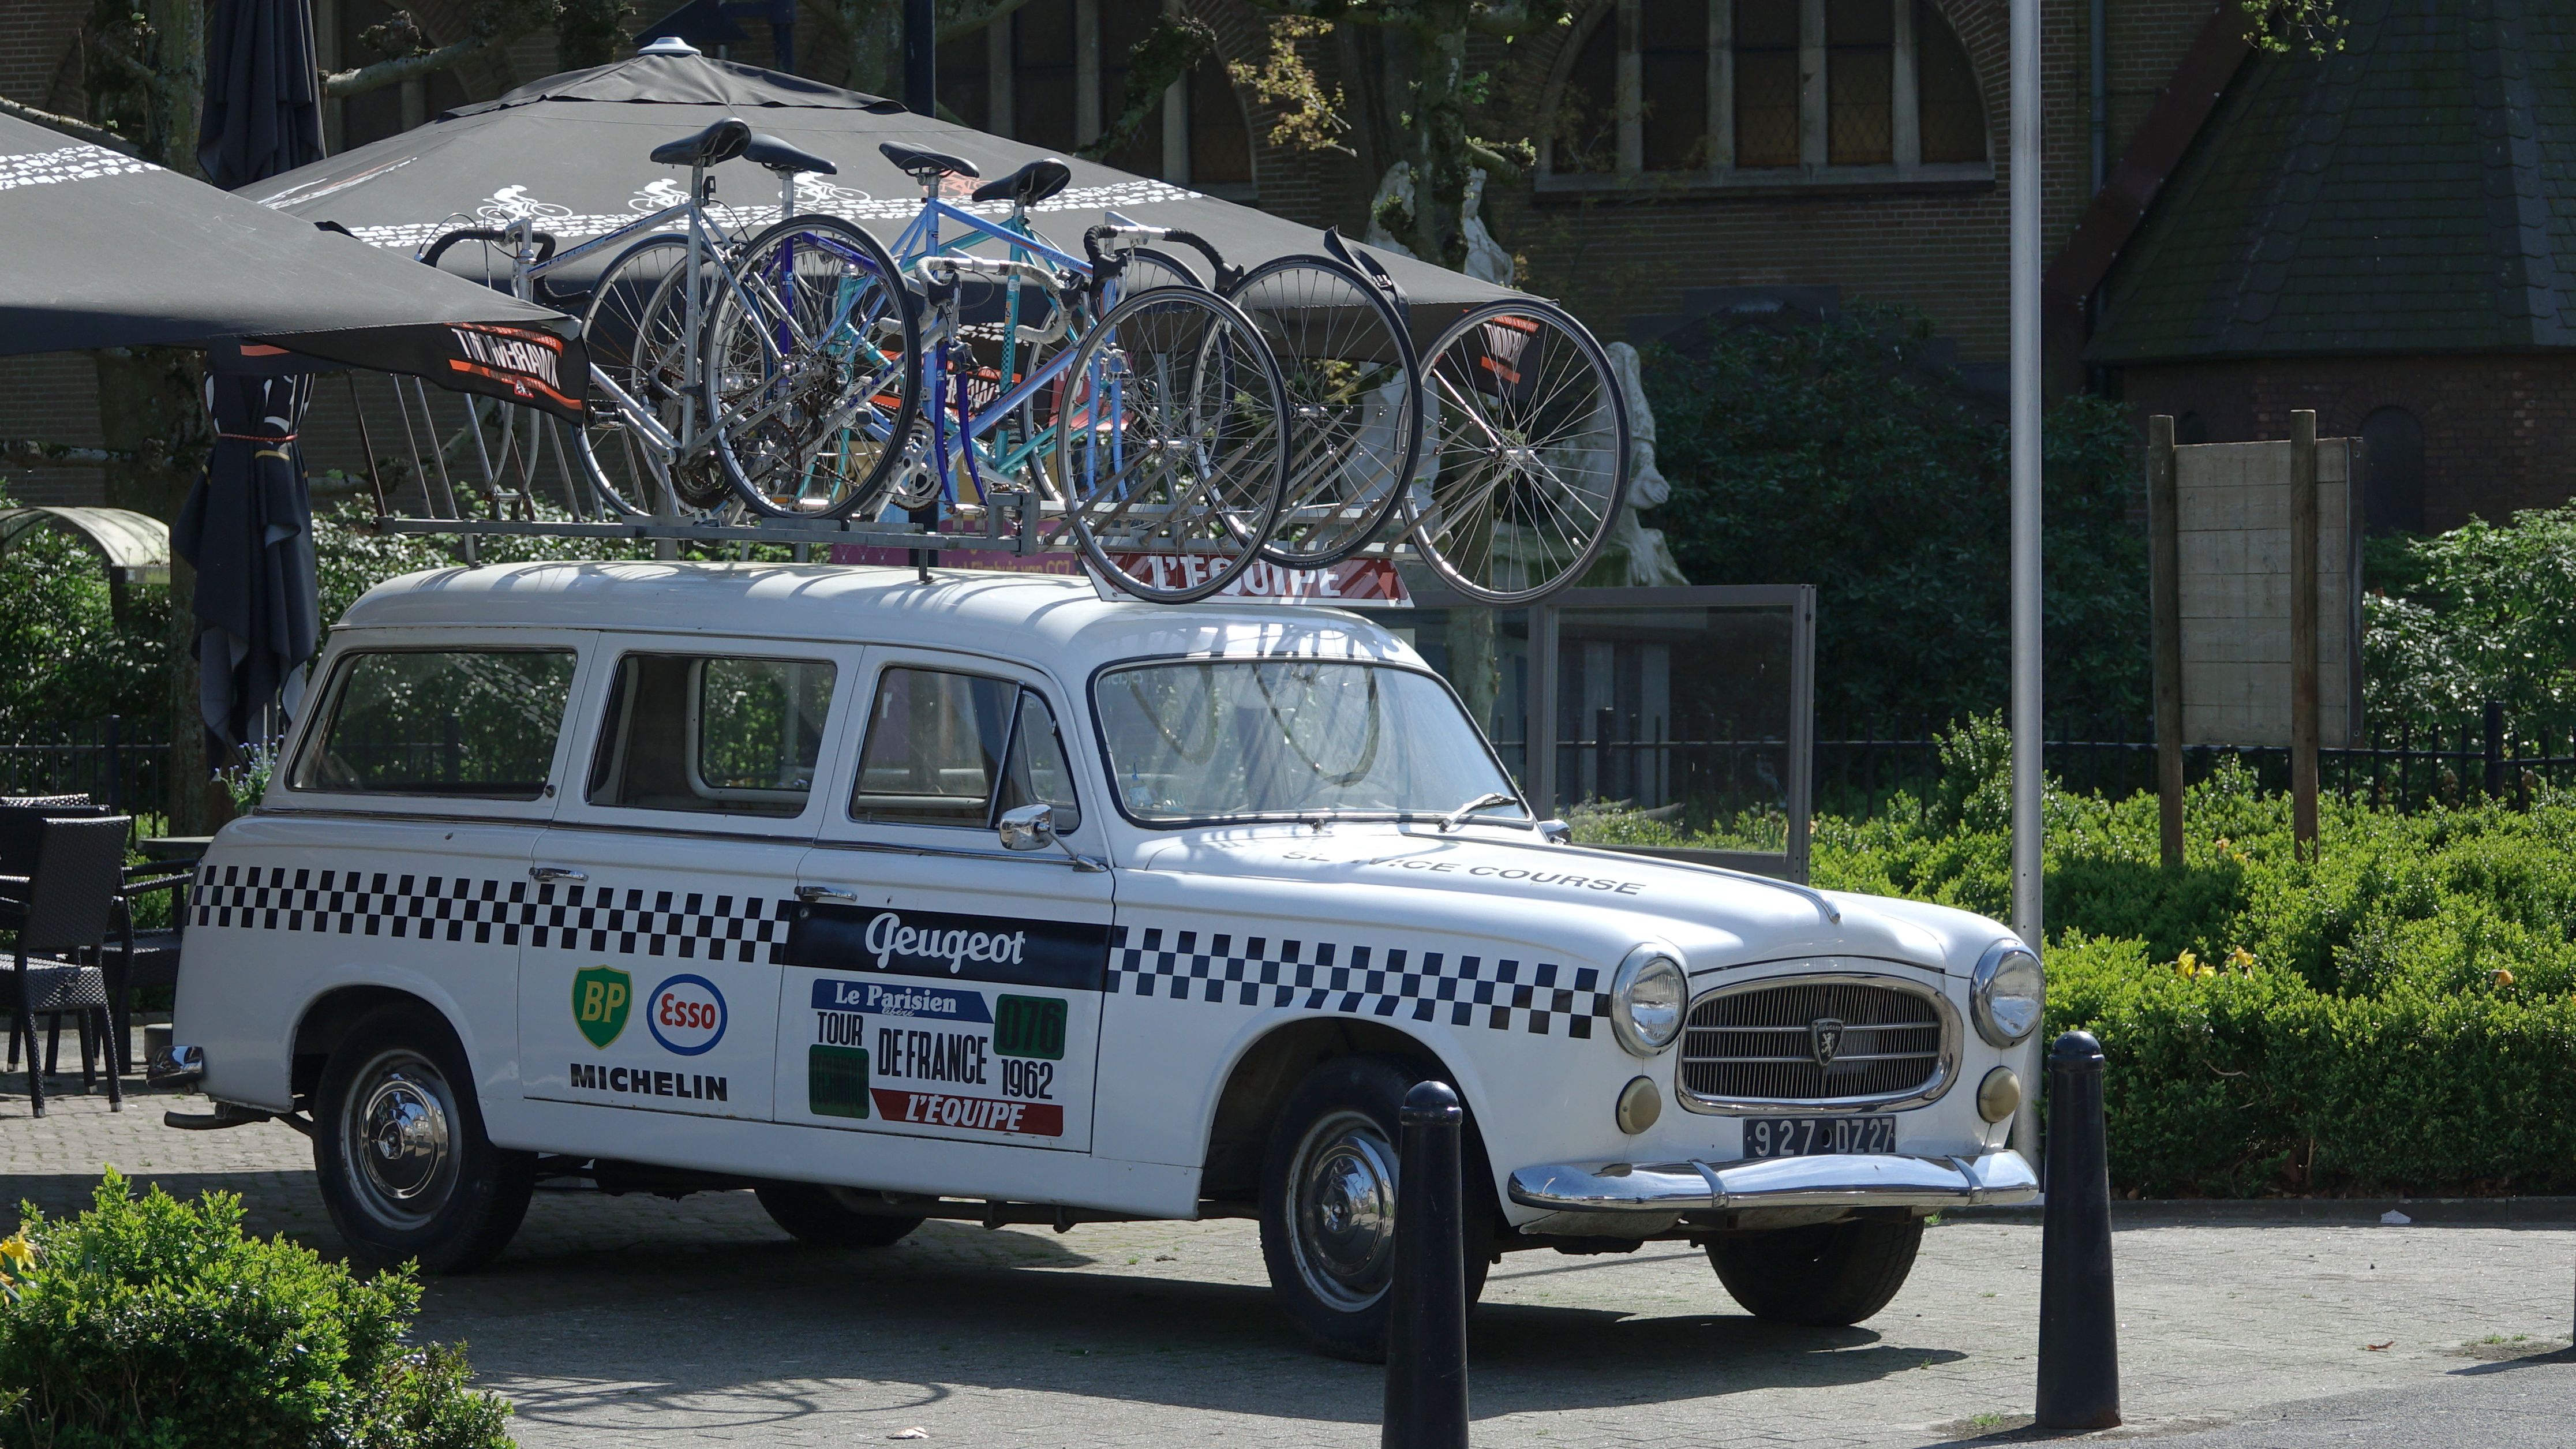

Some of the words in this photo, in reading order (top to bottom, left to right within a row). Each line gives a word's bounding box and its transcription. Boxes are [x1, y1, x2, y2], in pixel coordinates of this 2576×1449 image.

[1469, 866, 1647, 895] COURSE
[865, 912, 1026, 974] Peugeot
[581, 980, 626, 1023] BP
[835, 982, 860, 1006] Le
[866, 984, 957, 1013] Parisien
[817, 1012, 864, 1046] TOUR
[999, 998, 1062, 1053] 076
[878, 1027, 902, 1077] DE
[906, 1030, 989, 1085] FRANCE
[570, 1063, 728, 1102] MICHELIN
[1001, 1059, 1054, 1099] 1962
[1754, 1119, 1816, 1157] 927
